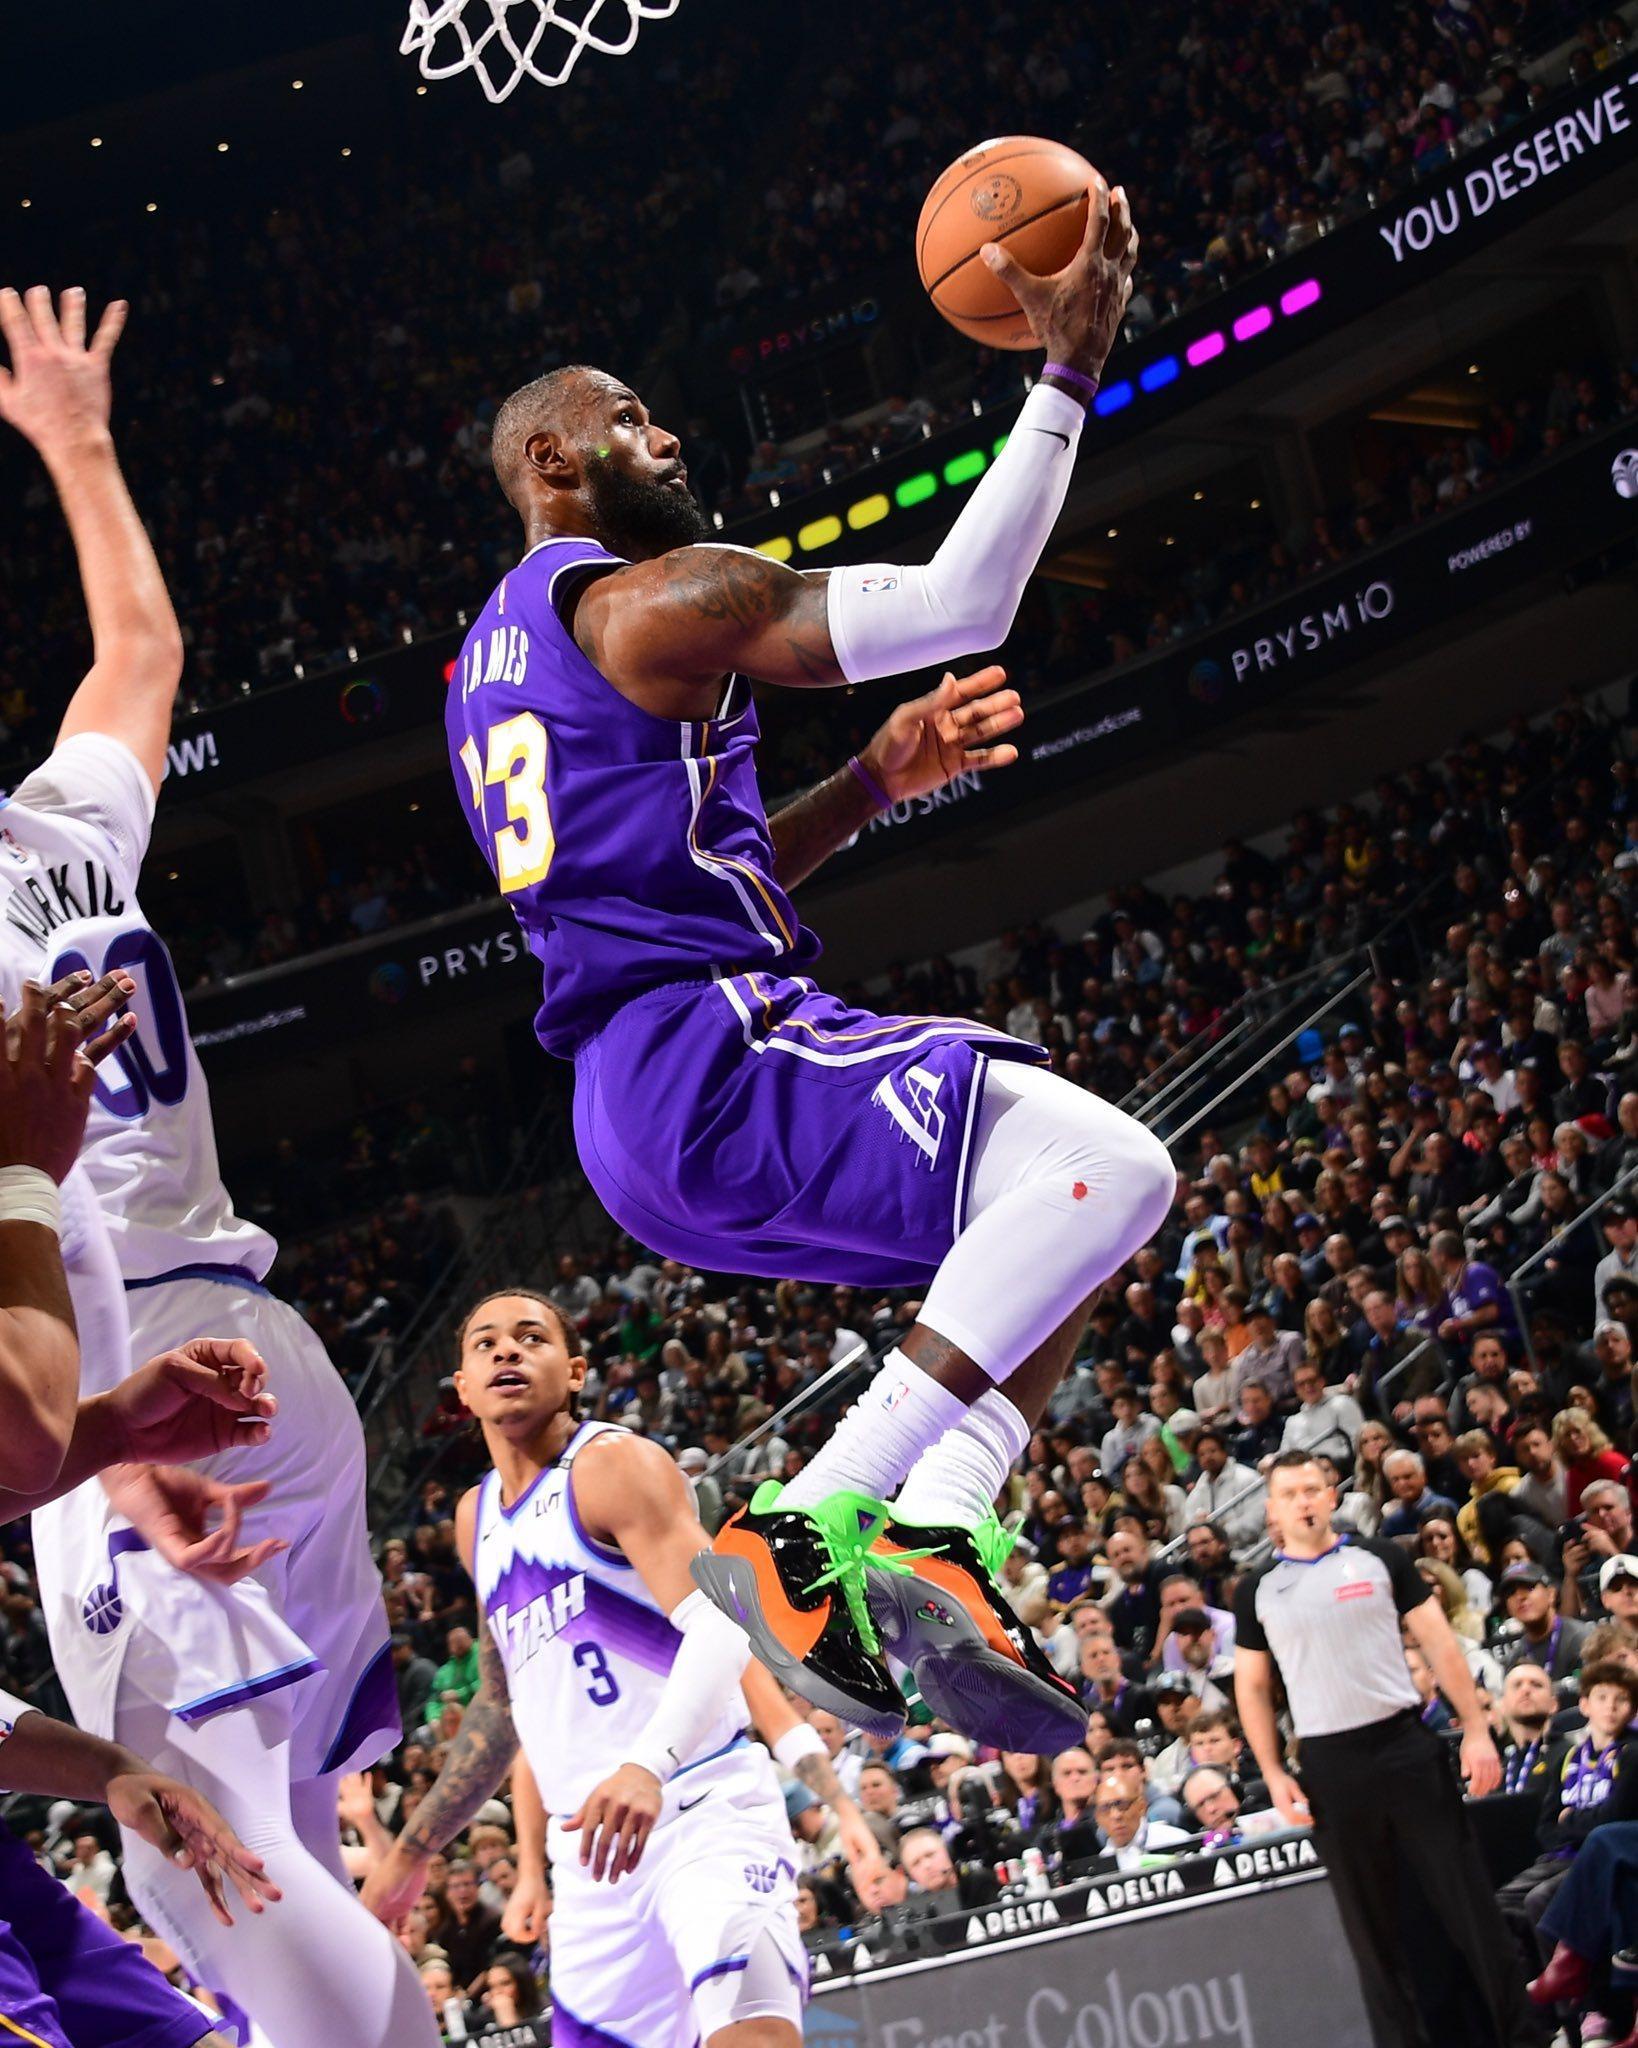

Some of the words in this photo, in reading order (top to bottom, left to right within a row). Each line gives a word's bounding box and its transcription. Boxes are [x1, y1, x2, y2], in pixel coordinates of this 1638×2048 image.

[1379, 187, 1461, 262] YOU
[1464, 85, 1632, 217] DESERVE
[1448, 529, 1515, 573] POWERED
[1514, 517, 1533, 541] BY
[462, 625, 528, 704] JAMES
[1231, 603, 1353, 682] PRYSM
[161, 730, 220, 782] W!
[918, 769, 983, 815] SKIN
[418, 930, 532, 987] PRYS
[487, 1570, 588, 1673] UTAH
[572, 1640, 620, 1707] 3
[1235, 1838, 1318, 1881] DELTA
[1107, 1868, 1186, 1911] DELTA
[986, 1899, 1061, 1938] DELTA
[1026, 1968, 1256, 2048] Colony
